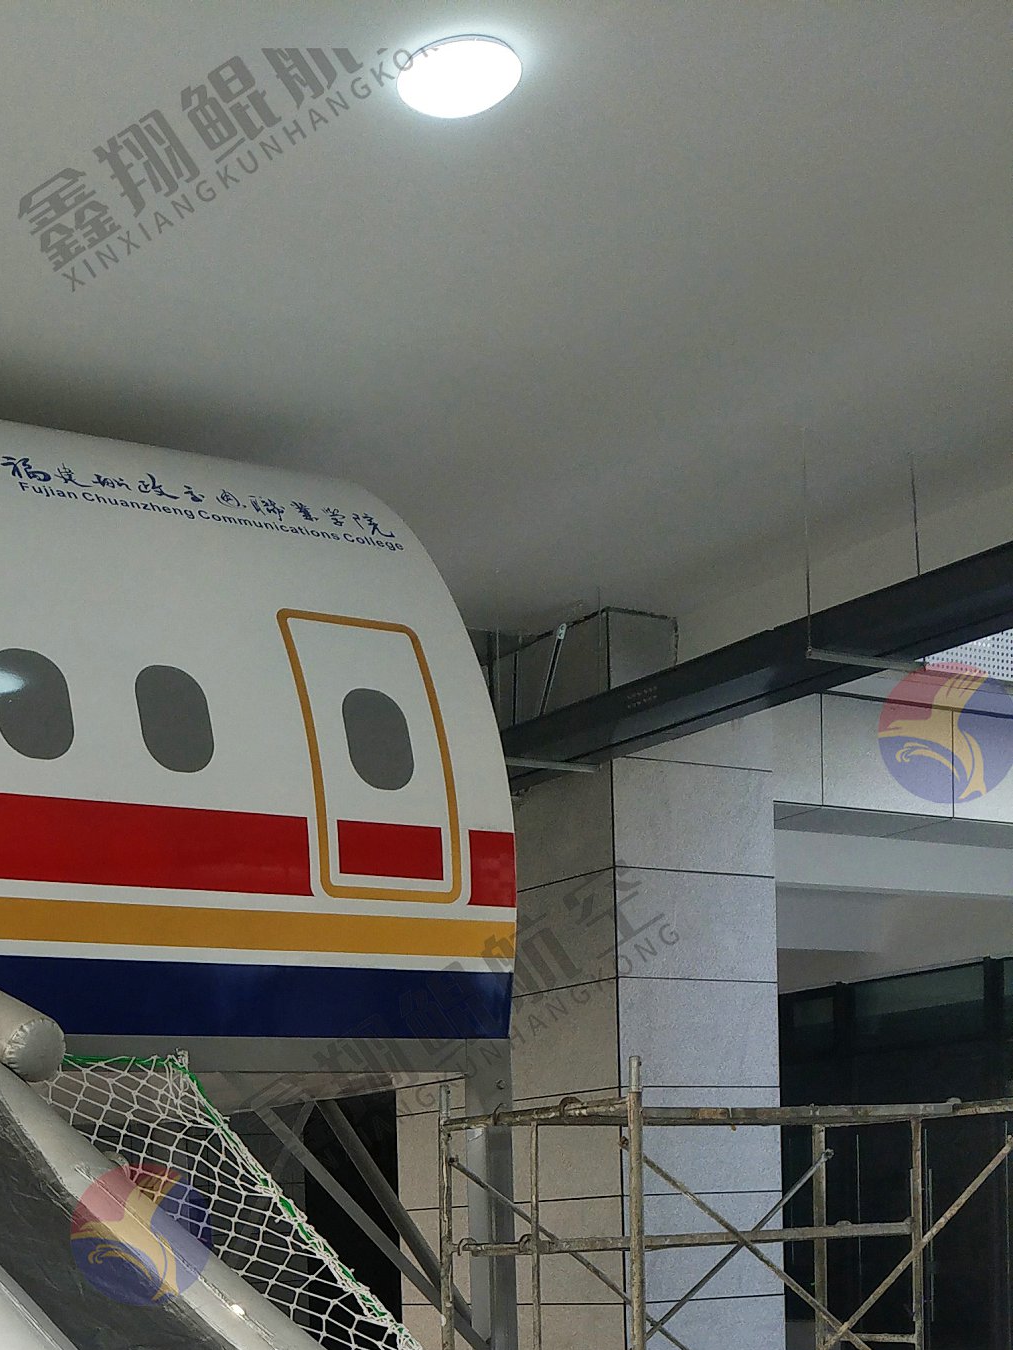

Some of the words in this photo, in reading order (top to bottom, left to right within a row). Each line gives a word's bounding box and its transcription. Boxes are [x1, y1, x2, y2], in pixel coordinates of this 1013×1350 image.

[18, 481, 79, 500] Fujian
[82, 492, 195, 519] Chuanzheng
[198, 509, 340, 541] Communications
[343, 533, 404, 551] College
